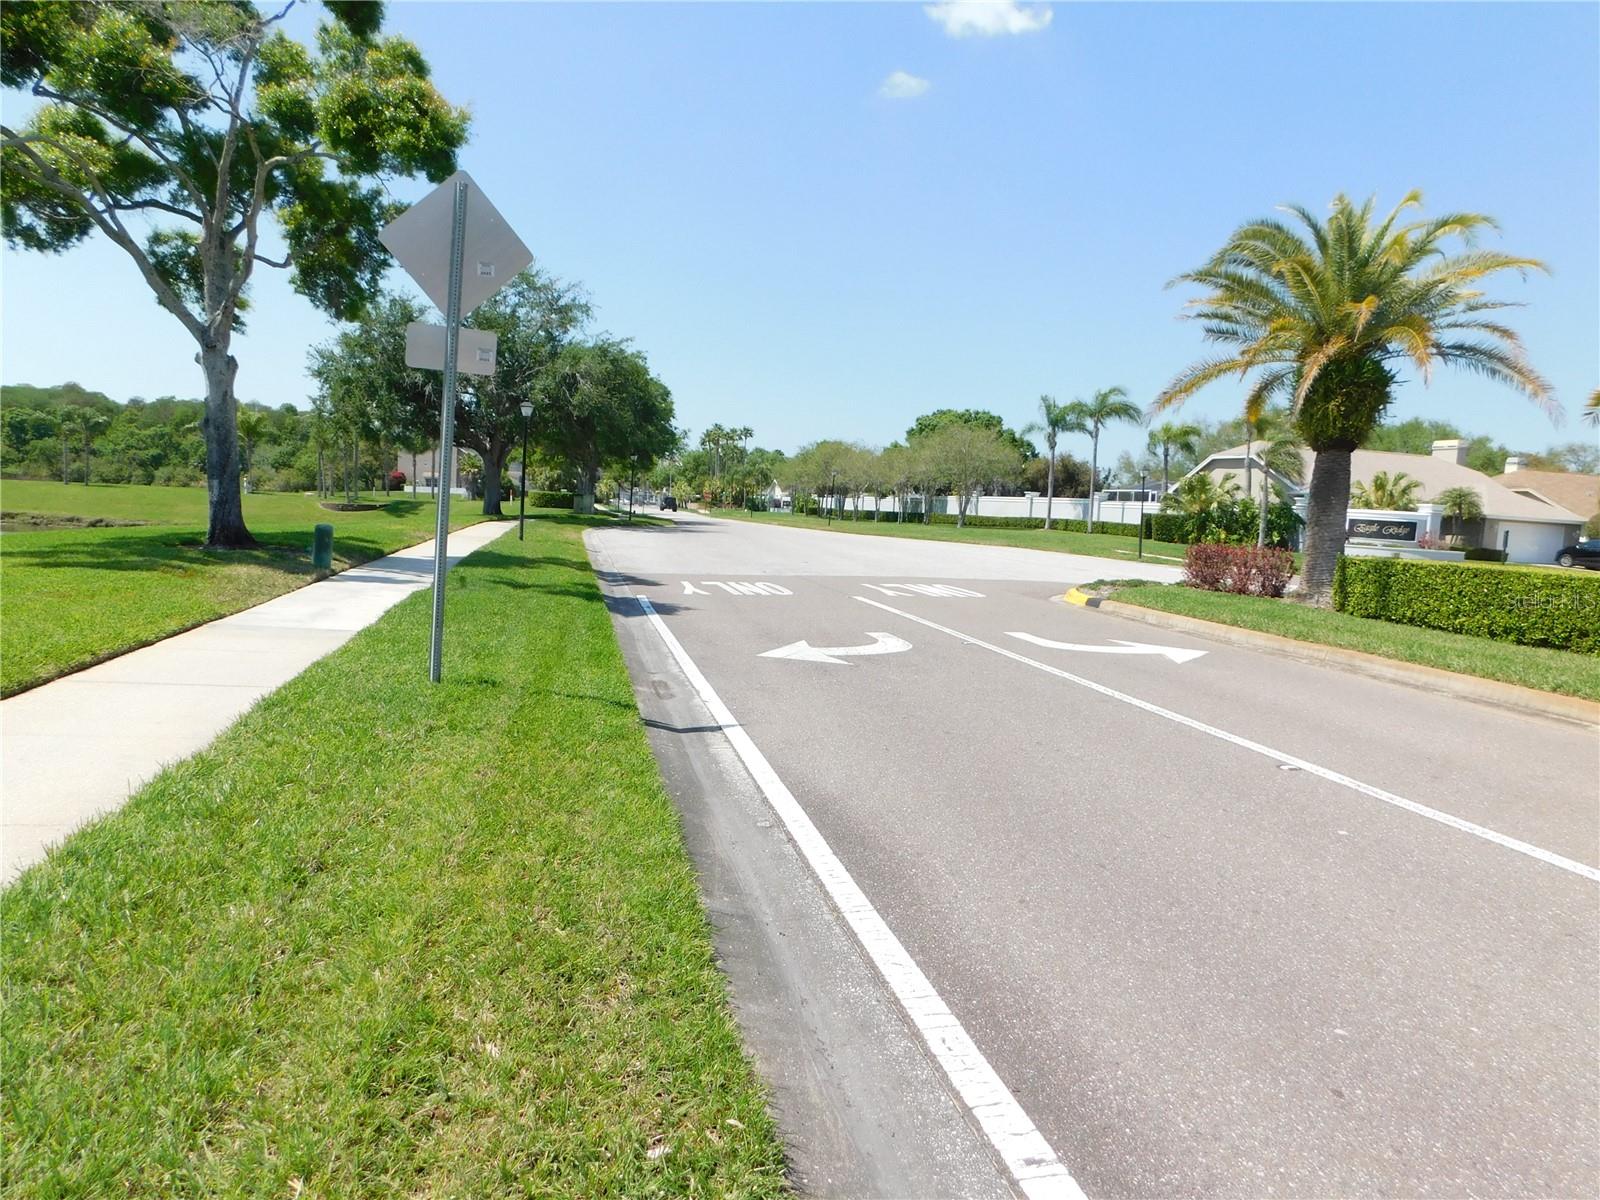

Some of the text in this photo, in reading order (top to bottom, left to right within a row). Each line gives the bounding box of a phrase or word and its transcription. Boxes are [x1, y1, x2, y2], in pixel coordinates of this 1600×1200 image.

[1354, 523, 1410, 536] Eagle Ridge
[680, 580, 794, 596] ONLY
[860, 583, 987, 598] ONLY
